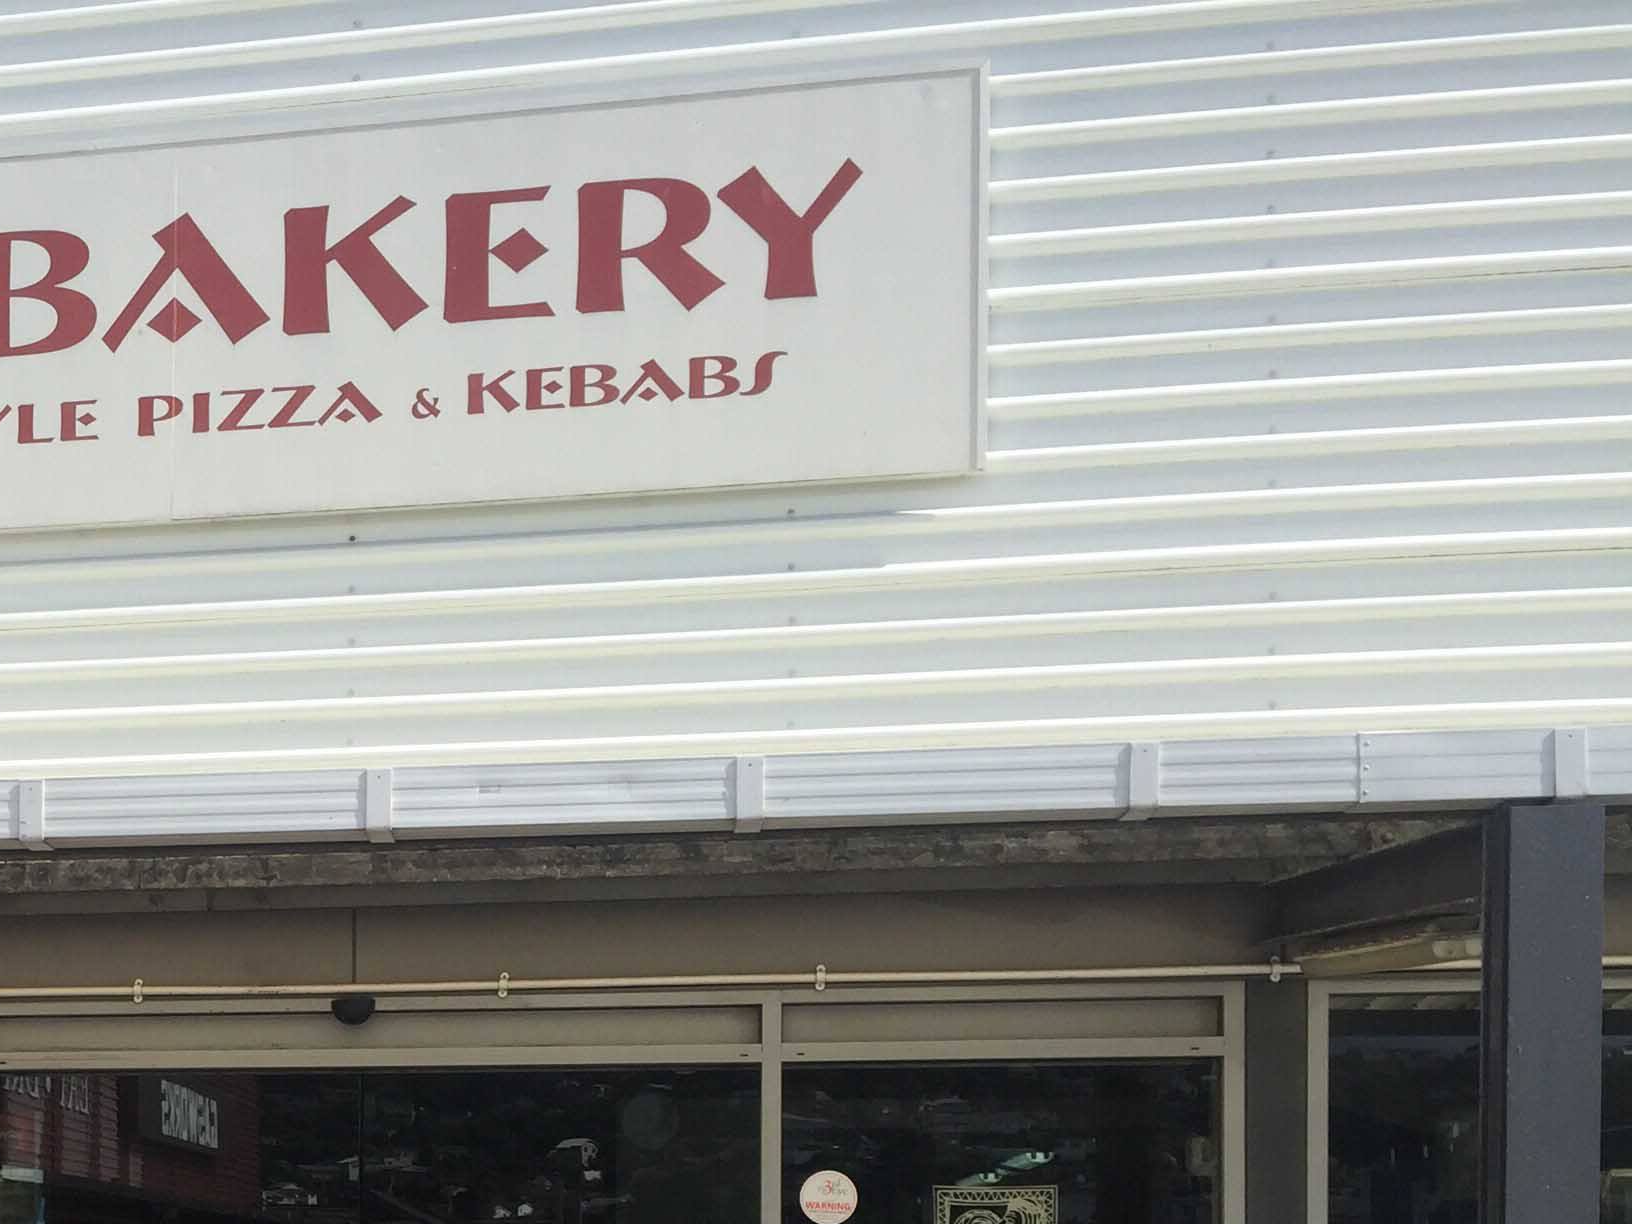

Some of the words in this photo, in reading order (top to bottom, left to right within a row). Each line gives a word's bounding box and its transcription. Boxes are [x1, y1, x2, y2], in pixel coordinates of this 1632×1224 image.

[138, 382, 383, 437] PIZZA
[411, 387, 442, 421] &
[468, 350, 789, 414] KEBABS
[805, 1201, 851, 1211] WARNING
